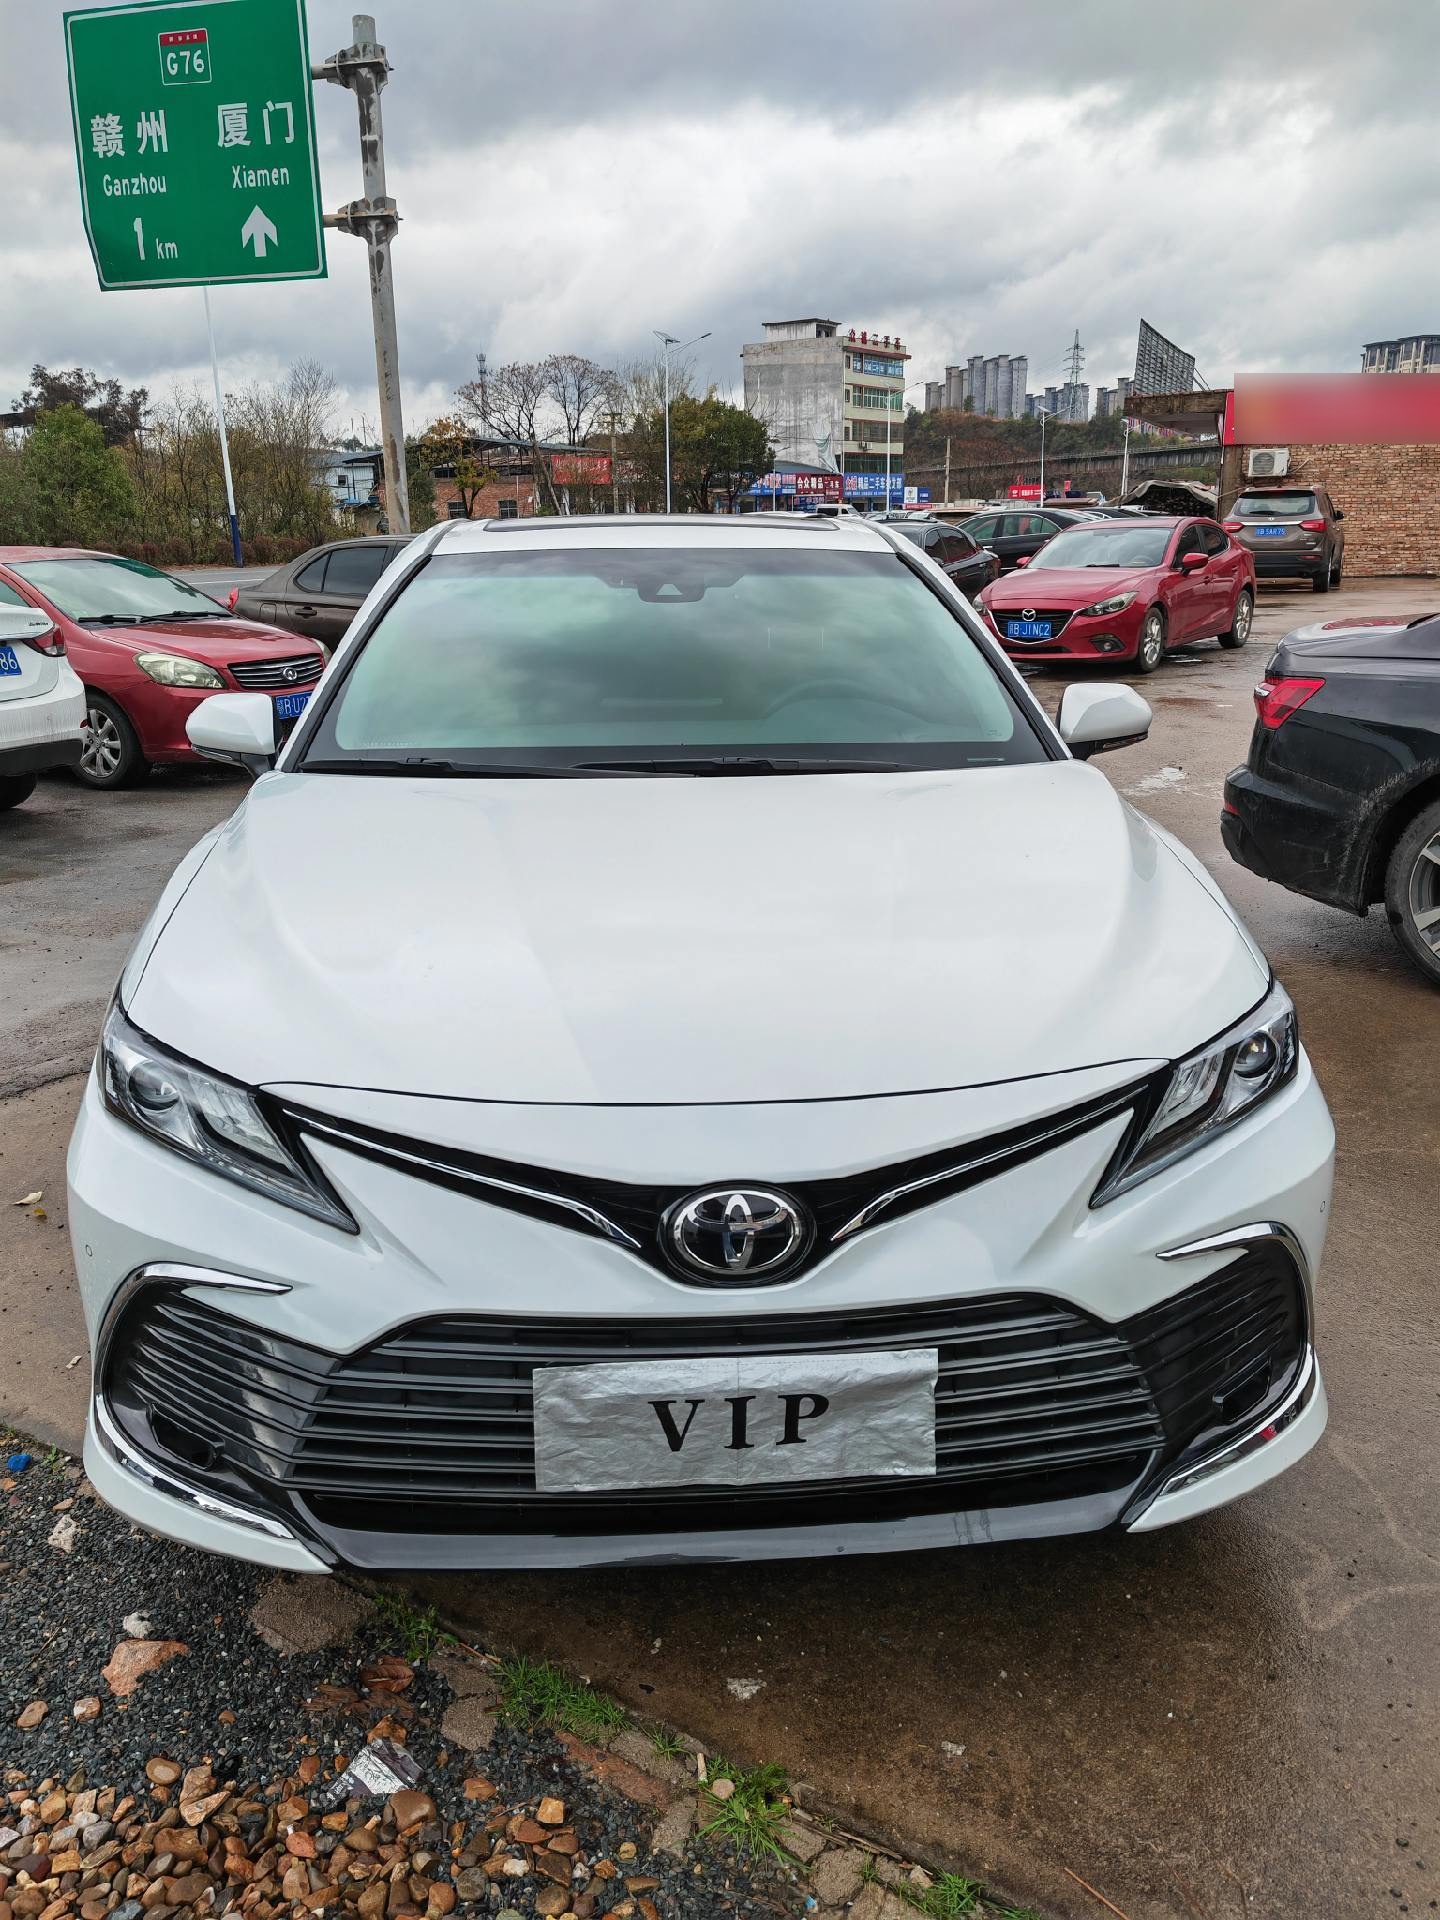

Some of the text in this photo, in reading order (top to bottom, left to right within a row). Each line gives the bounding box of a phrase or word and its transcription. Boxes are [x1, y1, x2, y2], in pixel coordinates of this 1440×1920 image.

[167, 50, 204, 75] G76
[91, 110, 168, 158] 赣州
[217, 101, 295, 148] 厦门
[103, 173, 167, 196] Ganzhou
[232, 165, 290, 189] Xiamen
[133, 218, 178, 260] 1 km
[648, 1394, 830, 1452] VIP
